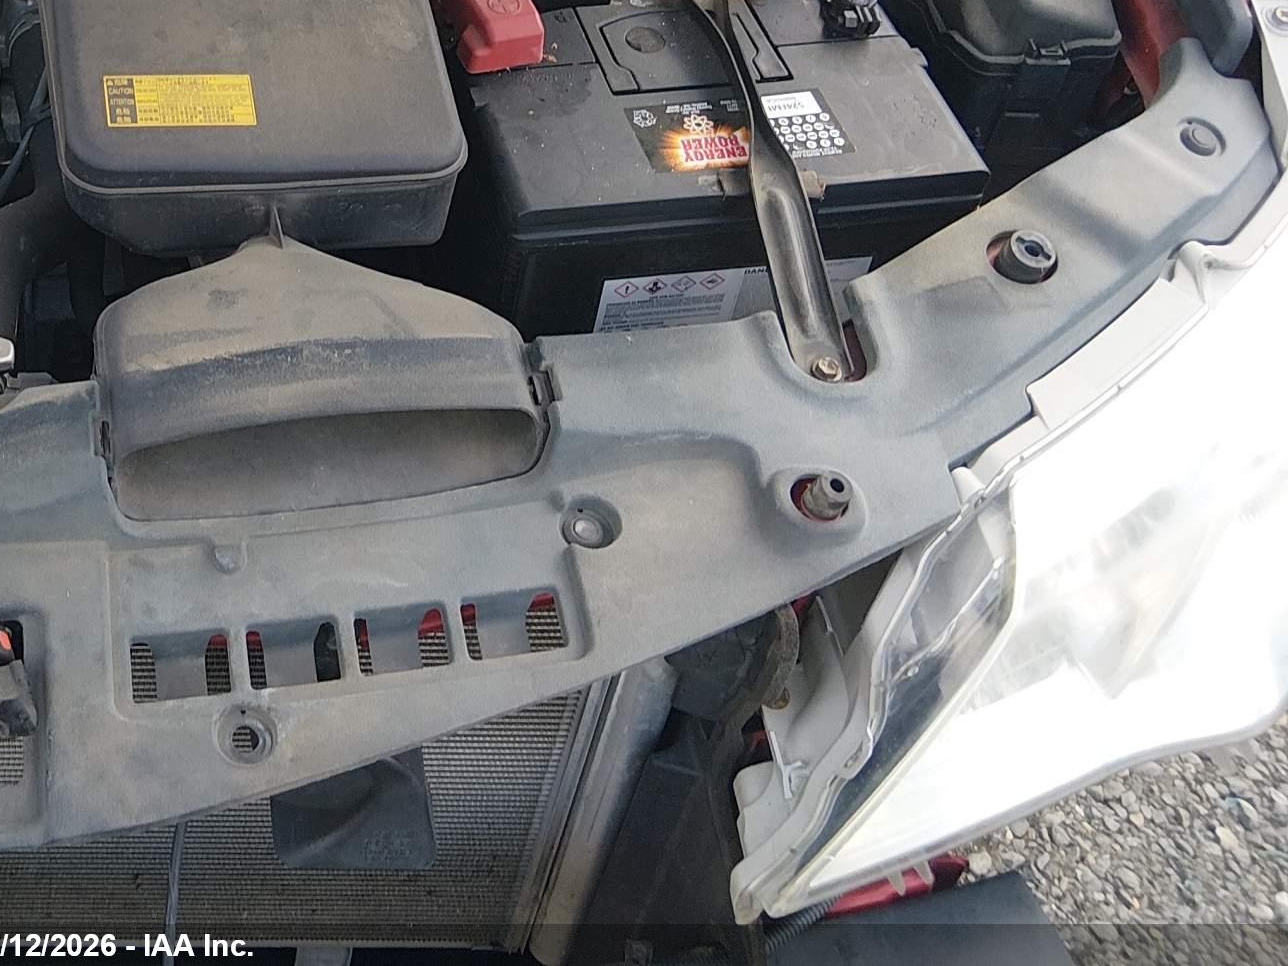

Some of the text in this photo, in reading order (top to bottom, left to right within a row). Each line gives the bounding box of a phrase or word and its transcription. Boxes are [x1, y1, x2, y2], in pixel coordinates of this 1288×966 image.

[109, 87, 134, 95] CAUTION
[681, 134, 741, 150] POWER
[684, 146, 748, 162] ENERGY
